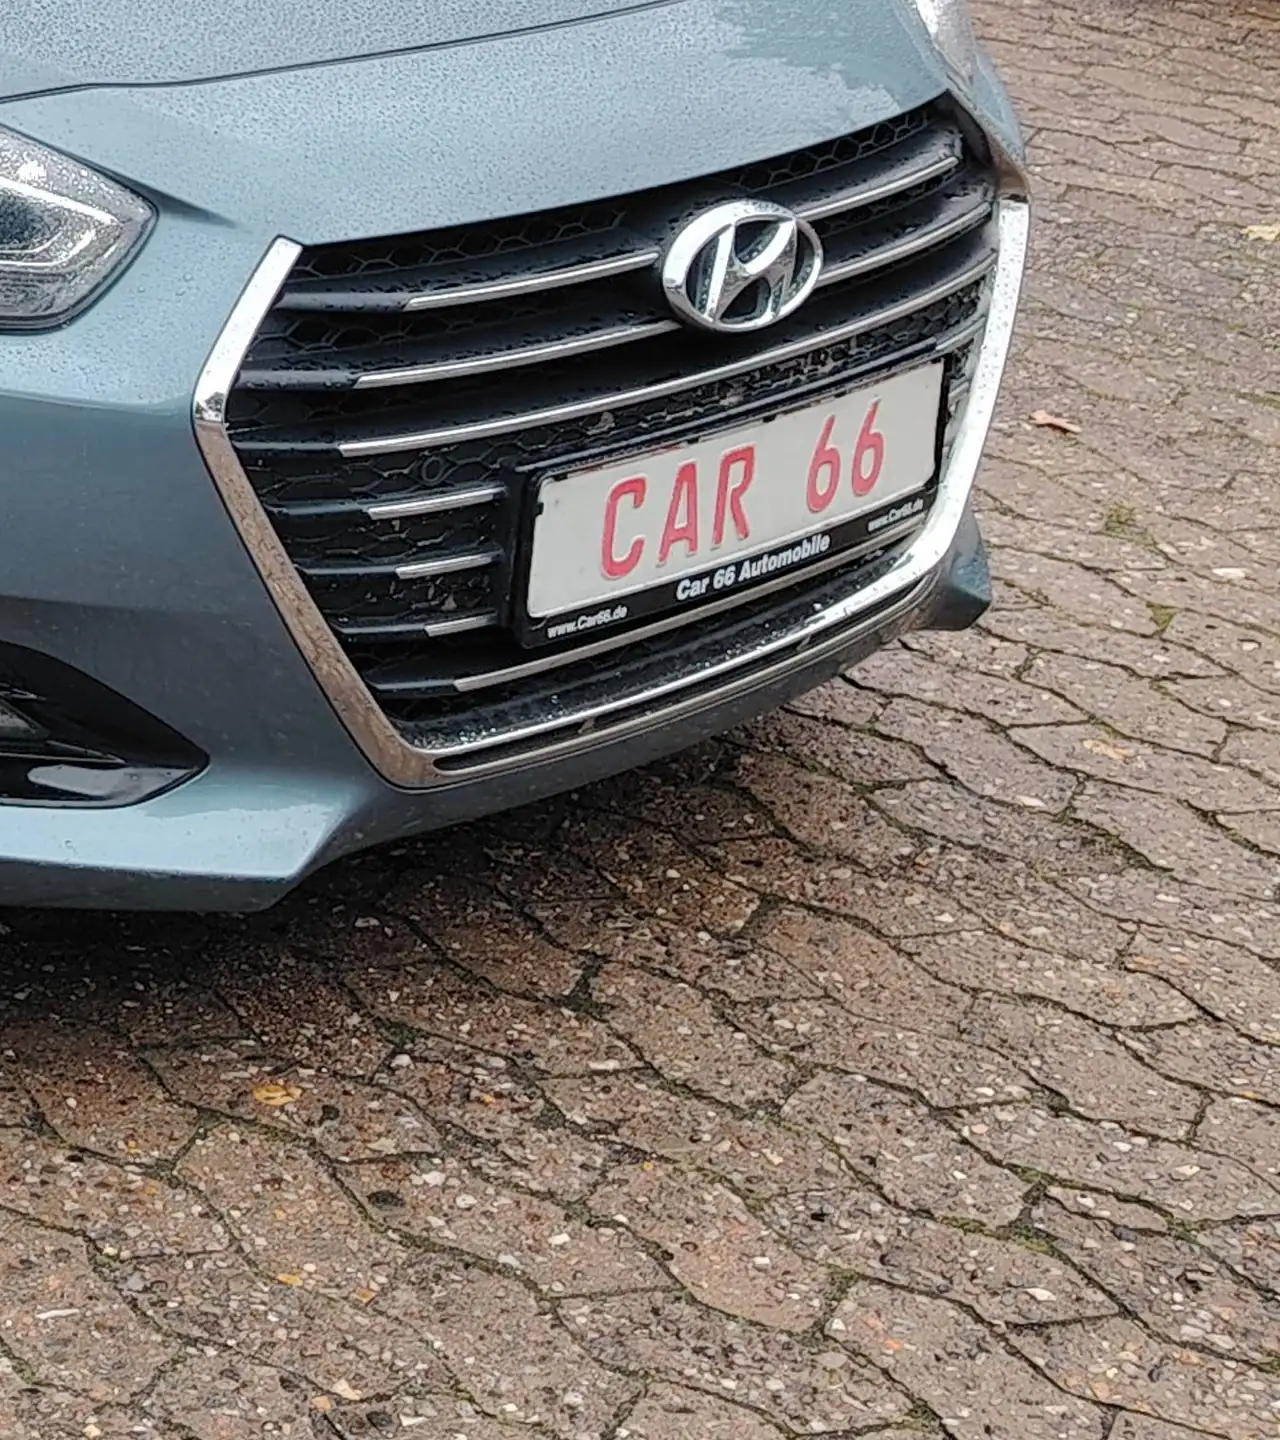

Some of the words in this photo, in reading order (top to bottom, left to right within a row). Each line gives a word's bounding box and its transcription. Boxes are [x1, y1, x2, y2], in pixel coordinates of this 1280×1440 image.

[600, 444, 756, 580] CAR
[805, 396, 886, 514] 66
[676, 577, 710, 601] Car
[713, 565, 736, 590] 66
[738, 533, 831, 582] Automobile
